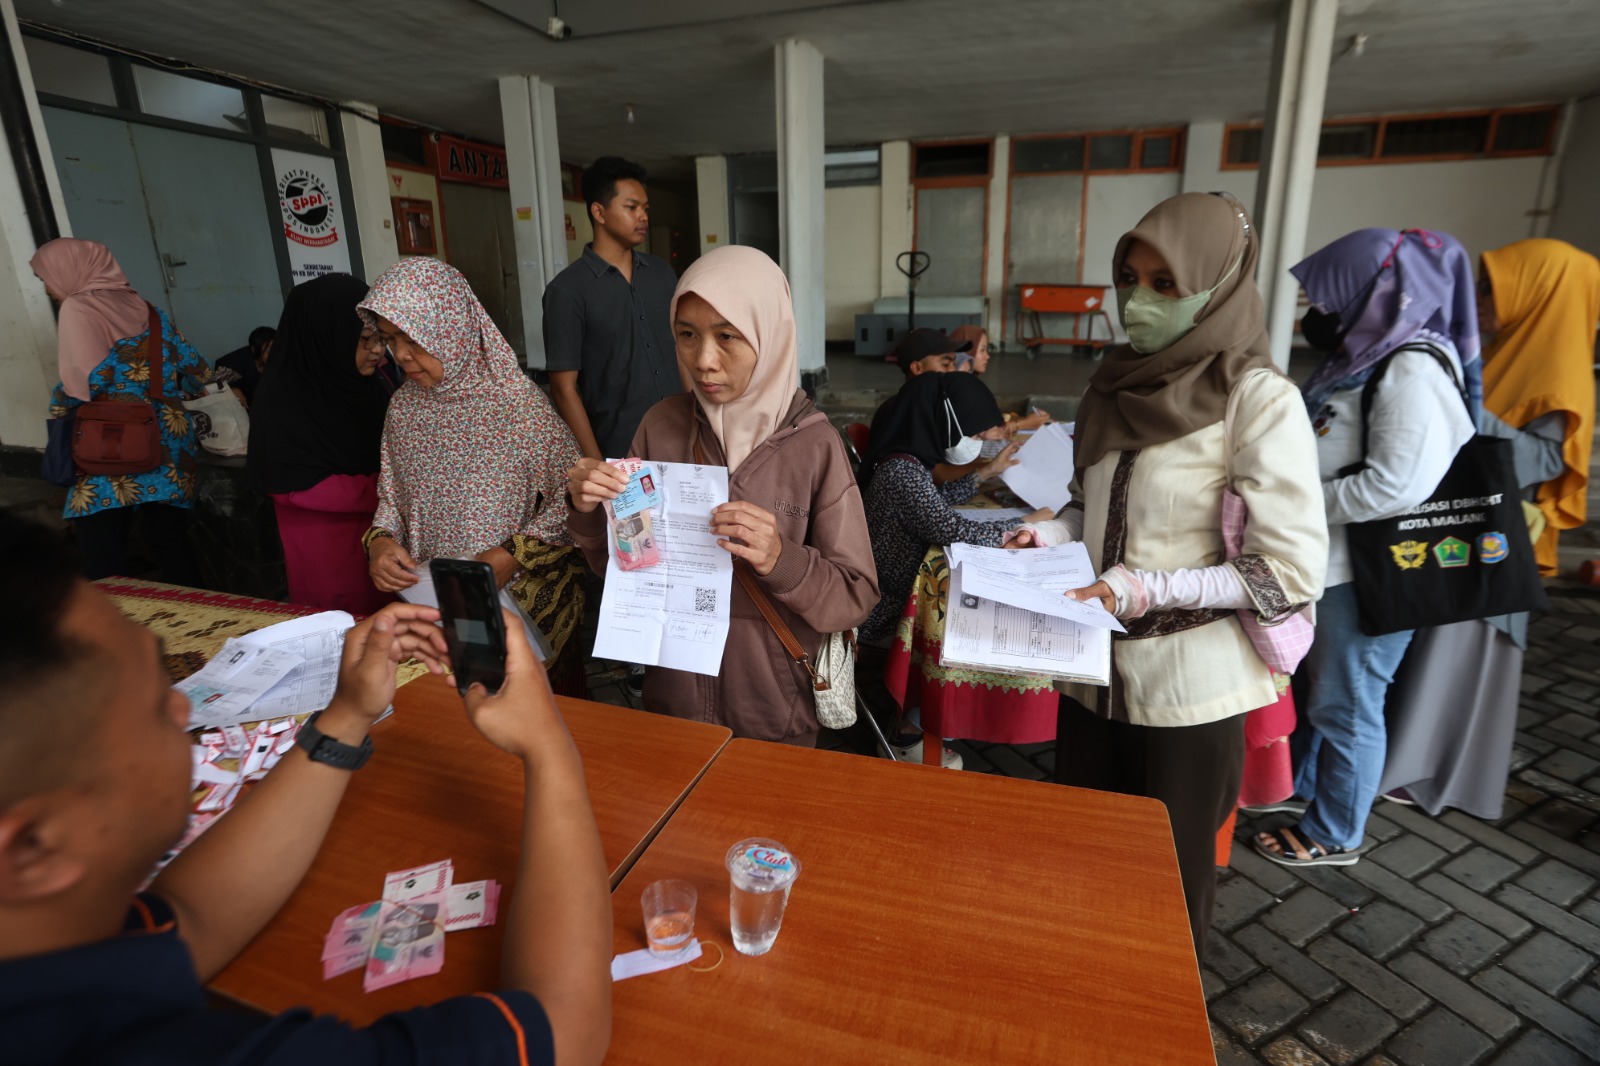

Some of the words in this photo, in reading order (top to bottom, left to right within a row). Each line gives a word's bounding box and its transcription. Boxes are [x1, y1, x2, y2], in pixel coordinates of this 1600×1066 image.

[449, 144, 508, 179] ANTA
[279, 169, 298, 201] SERIKAT
[292, 193, 322, 211] SPPI
[283, 208, 298, 226] POS
[299, 208, 334, 235] INDONESIA
[1398, 518, 1431, 531] KOTA
[753, 849, 788, 866] Club
